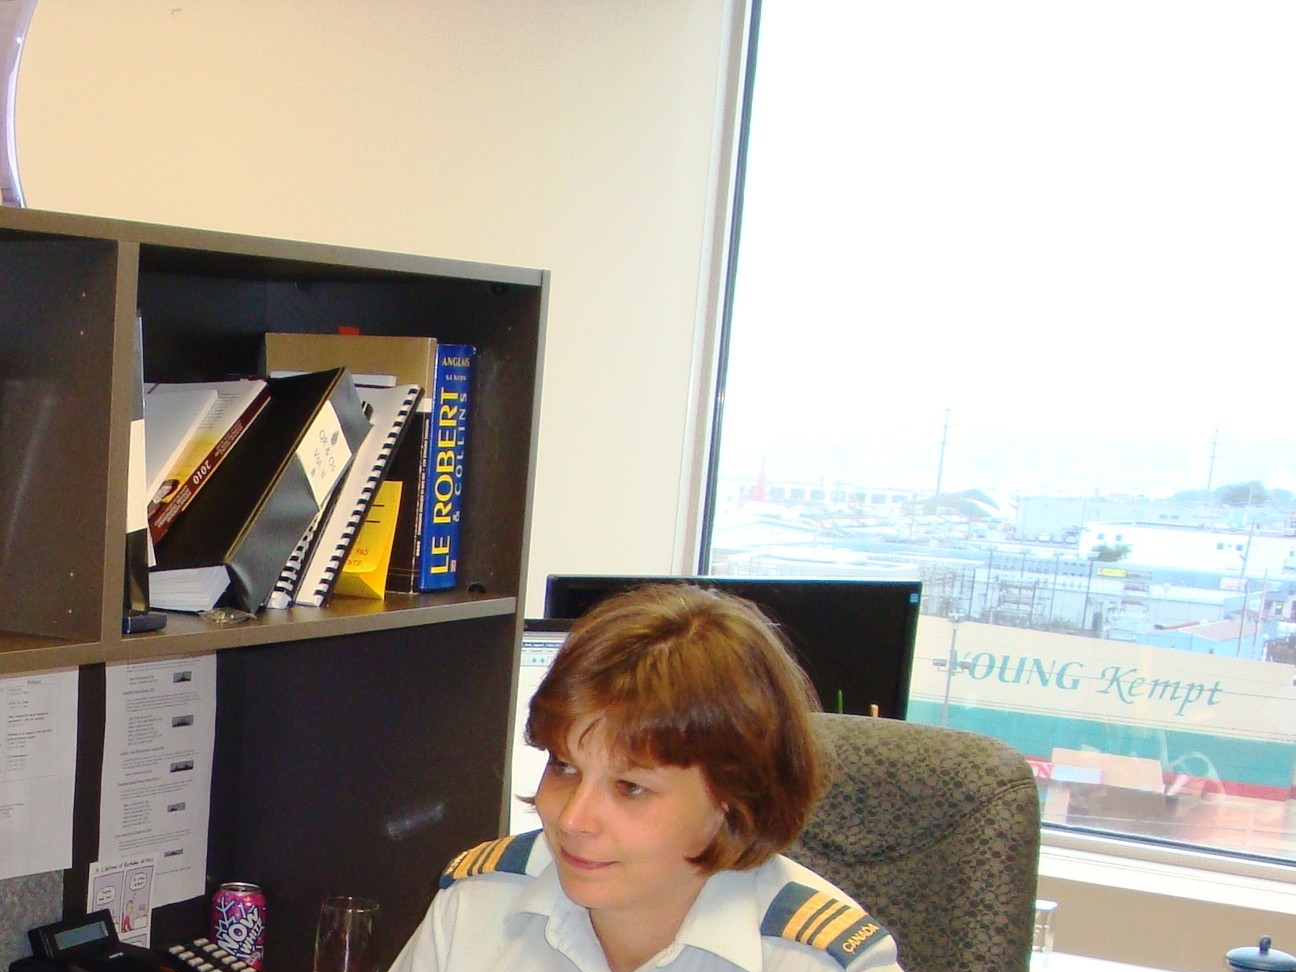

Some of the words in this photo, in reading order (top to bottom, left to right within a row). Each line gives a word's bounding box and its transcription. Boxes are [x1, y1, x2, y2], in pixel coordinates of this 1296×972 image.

[433, 387, 459, 523] ROBERT
[454, 393, 467, 495] COLLINS
[192, 460, 213, 485] 2010
[452, 511, 460, 522] &
[430, 535, 450, 574] LE
[950, 649, 1085, 692] YOUNG
[1097, 665, 1222, 717] Kempt
[240, 919, 263, 953] WHITE
[842, 922, 880, 954] CANADA
